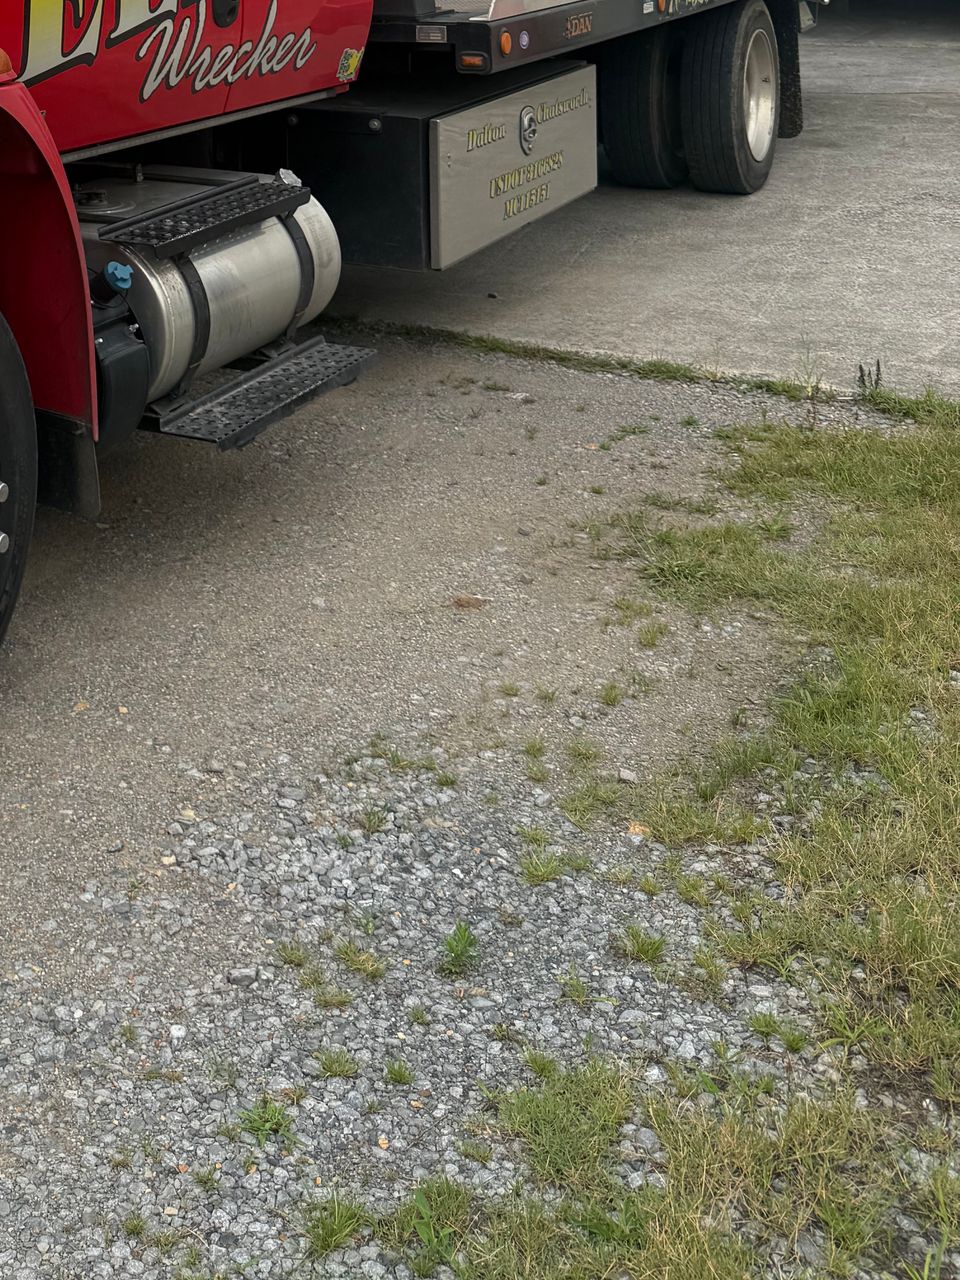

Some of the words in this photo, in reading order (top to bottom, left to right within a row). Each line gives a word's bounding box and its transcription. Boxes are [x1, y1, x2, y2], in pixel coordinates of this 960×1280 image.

[536, 88, 591, 125] Chatsworth
[466, 123, 507, 153] Dalton
[488, 165, 527, 199] USDOT
